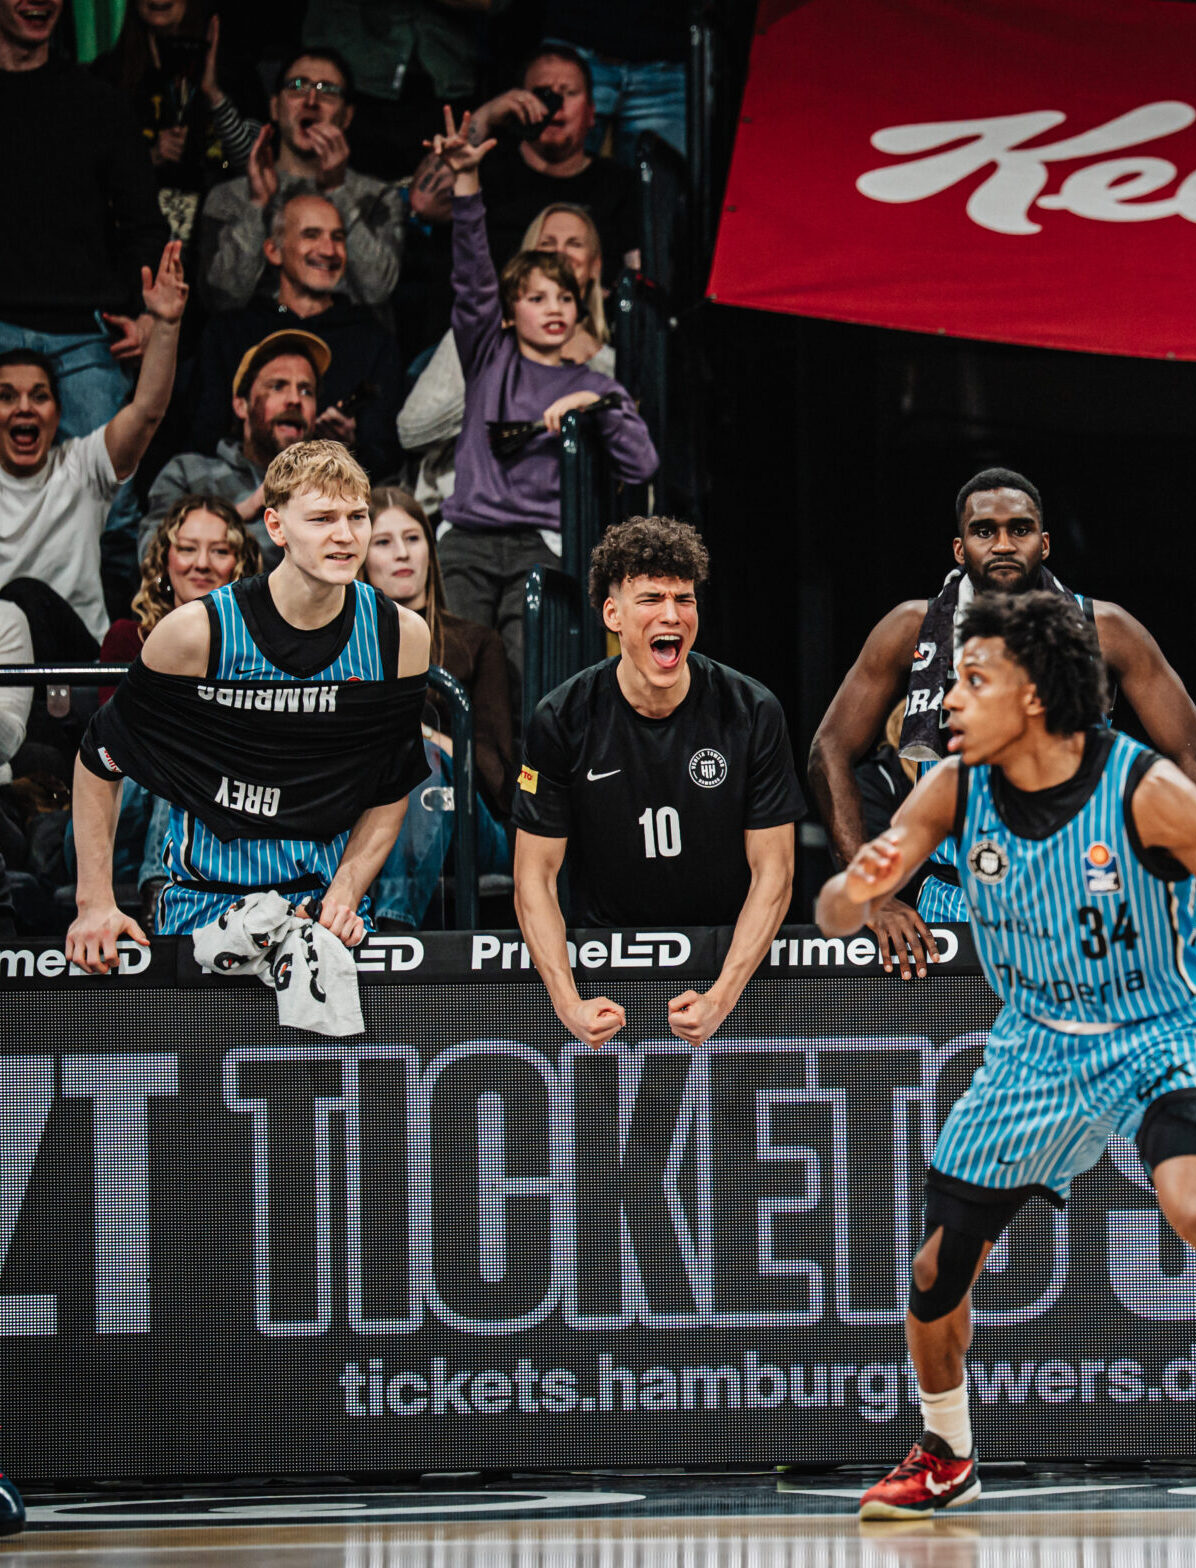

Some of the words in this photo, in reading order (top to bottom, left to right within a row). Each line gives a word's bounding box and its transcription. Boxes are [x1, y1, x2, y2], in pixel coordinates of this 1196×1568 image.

[214, 776, 281, 817] GREY
[638, 805, 682, 858] 10
[471, 931, 692, 970] PrieLED
[1078, 901, 1139, 961] 34
